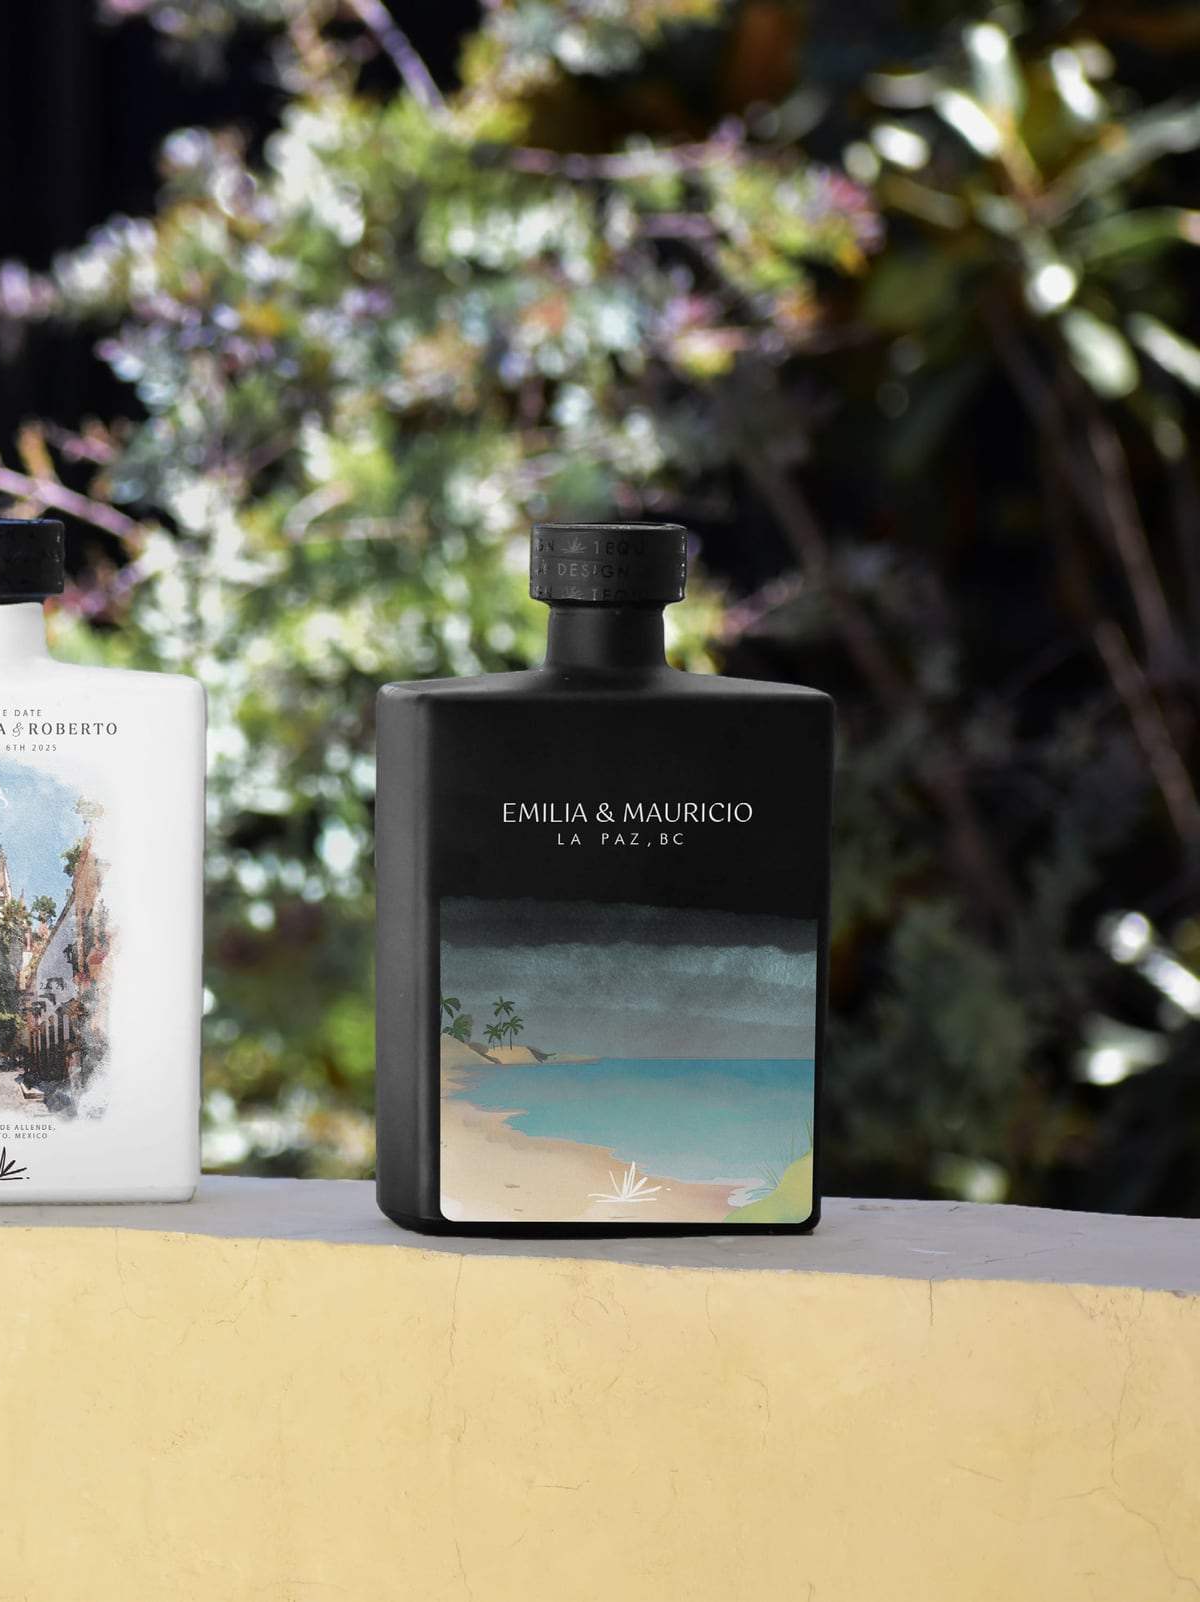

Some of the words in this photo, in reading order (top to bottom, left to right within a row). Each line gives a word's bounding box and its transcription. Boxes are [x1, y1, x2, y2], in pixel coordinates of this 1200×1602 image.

[557, 563, 630, 578] DESIGN
[14, 708, 42, 717] DATE
[12, 721, 25, 738] &
[28, 721, 118, 736] ROBERTO
[5, 743, 26, 752] 6TH
[31, 743, 57, 752] 2025
[503, 802, 588, 823] EMILIA
[595, 802, 616, 823] &
[623, 802, 753, 823] MAURICIO
[557, 832, 582, 846] LA
[14, 1132, 48, 1140] MEXICO
